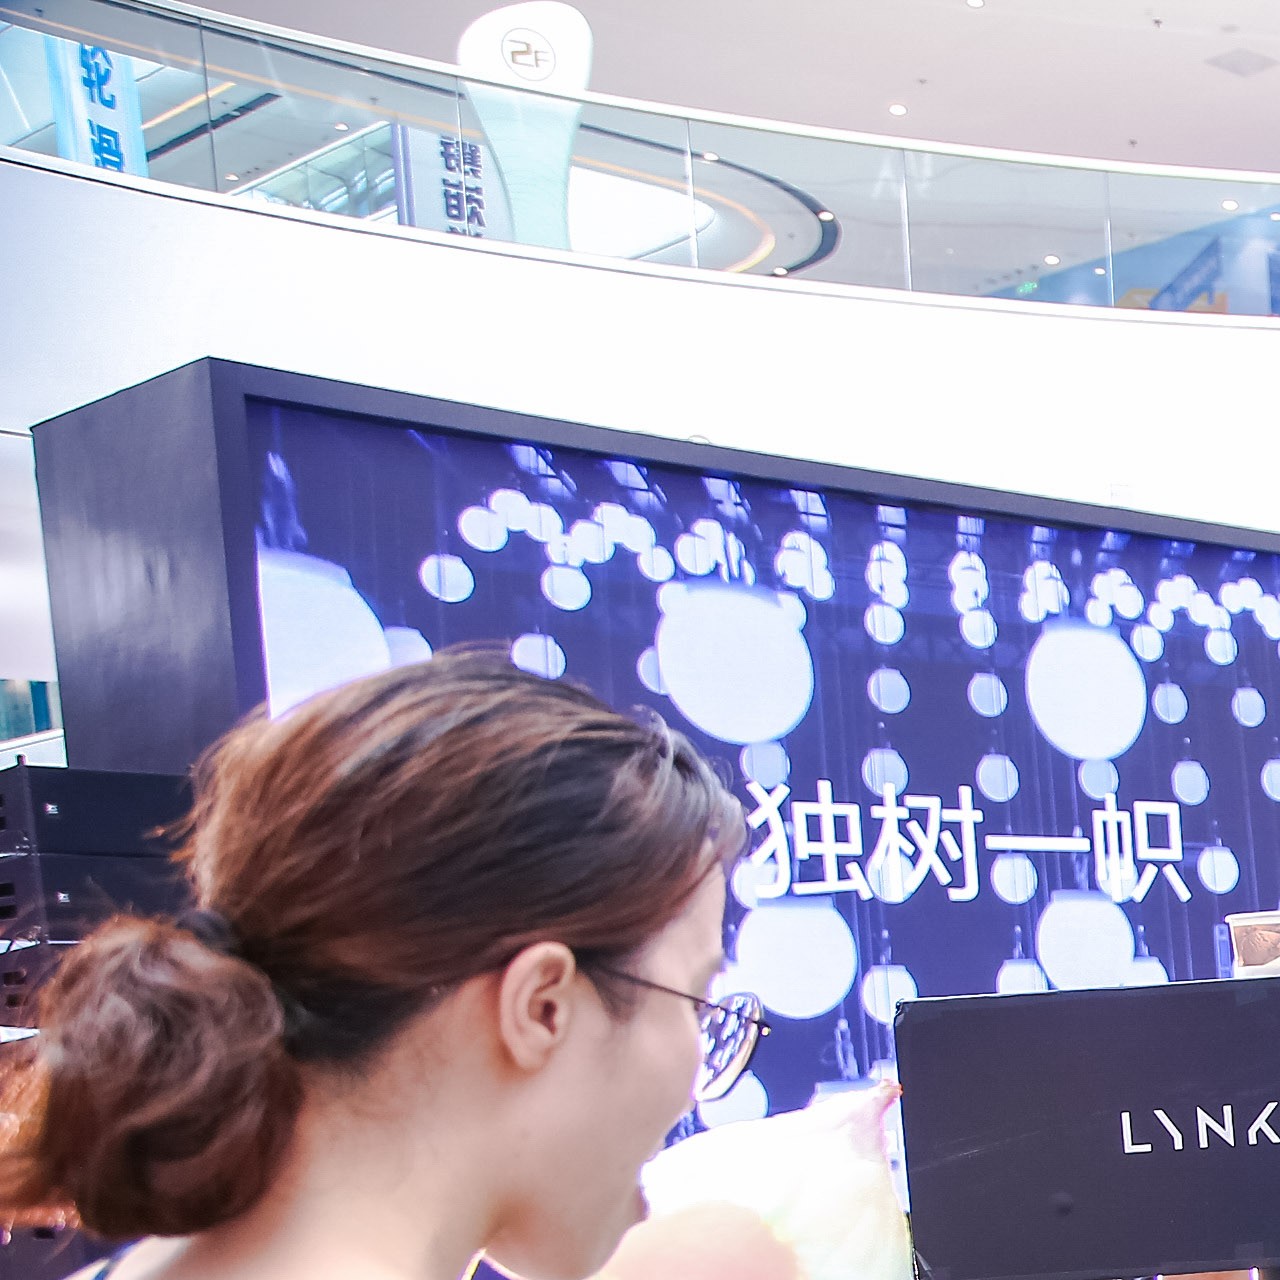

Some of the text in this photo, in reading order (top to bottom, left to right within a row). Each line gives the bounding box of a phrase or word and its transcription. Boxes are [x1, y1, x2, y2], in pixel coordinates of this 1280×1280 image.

[508, 39, 550, 68] 2F
[745, 777, 1193, 903] 独树一帜
